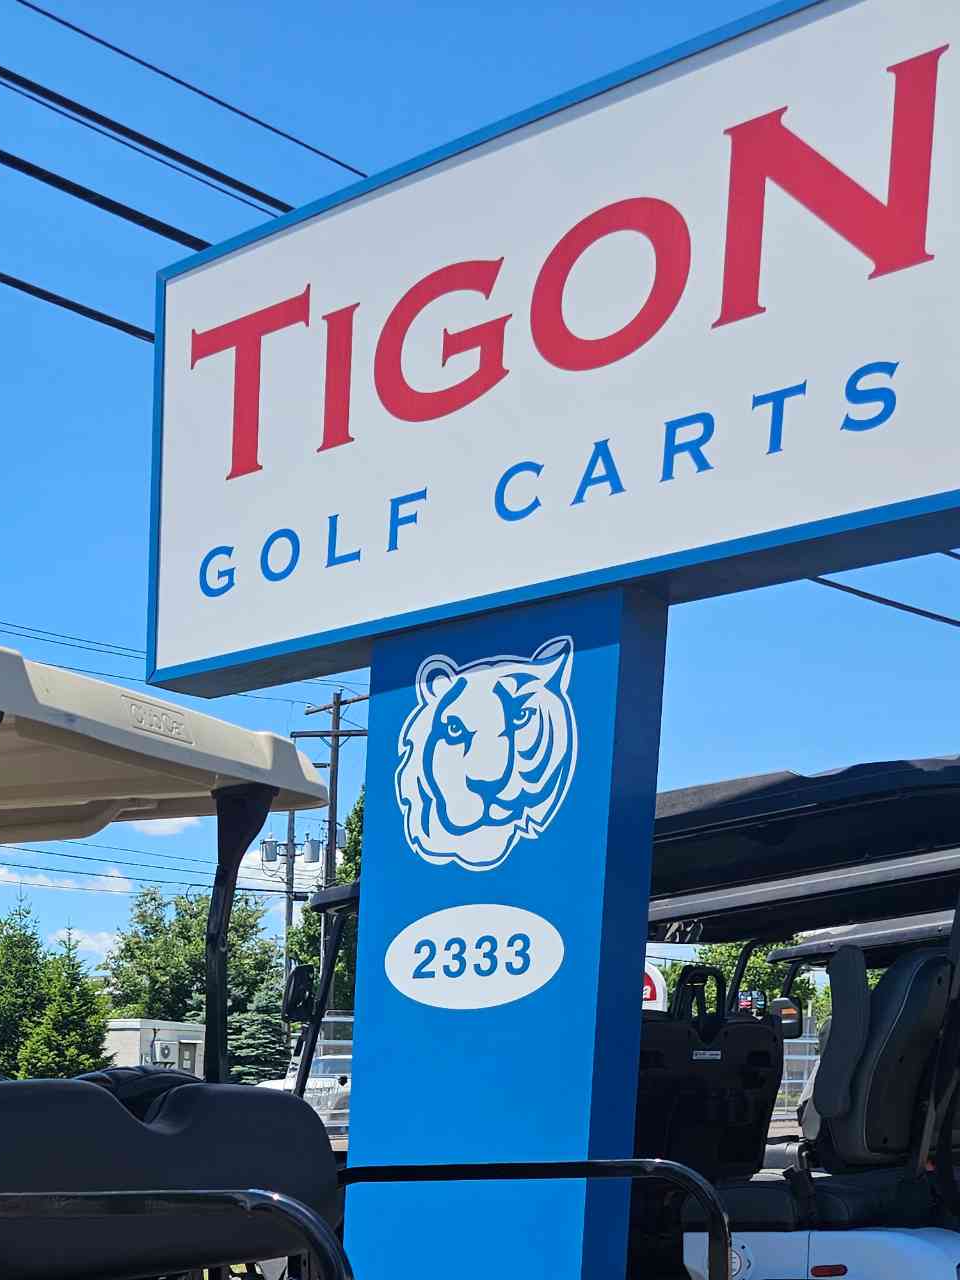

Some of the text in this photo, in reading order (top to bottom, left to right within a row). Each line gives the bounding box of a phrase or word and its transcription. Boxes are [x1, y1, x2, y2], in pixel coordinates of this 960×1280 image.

[191, 44, 950, 480] TIGON
[199, 361, 900, 598] GOLF CARTS
[412, 932, 532, 979] 2333
